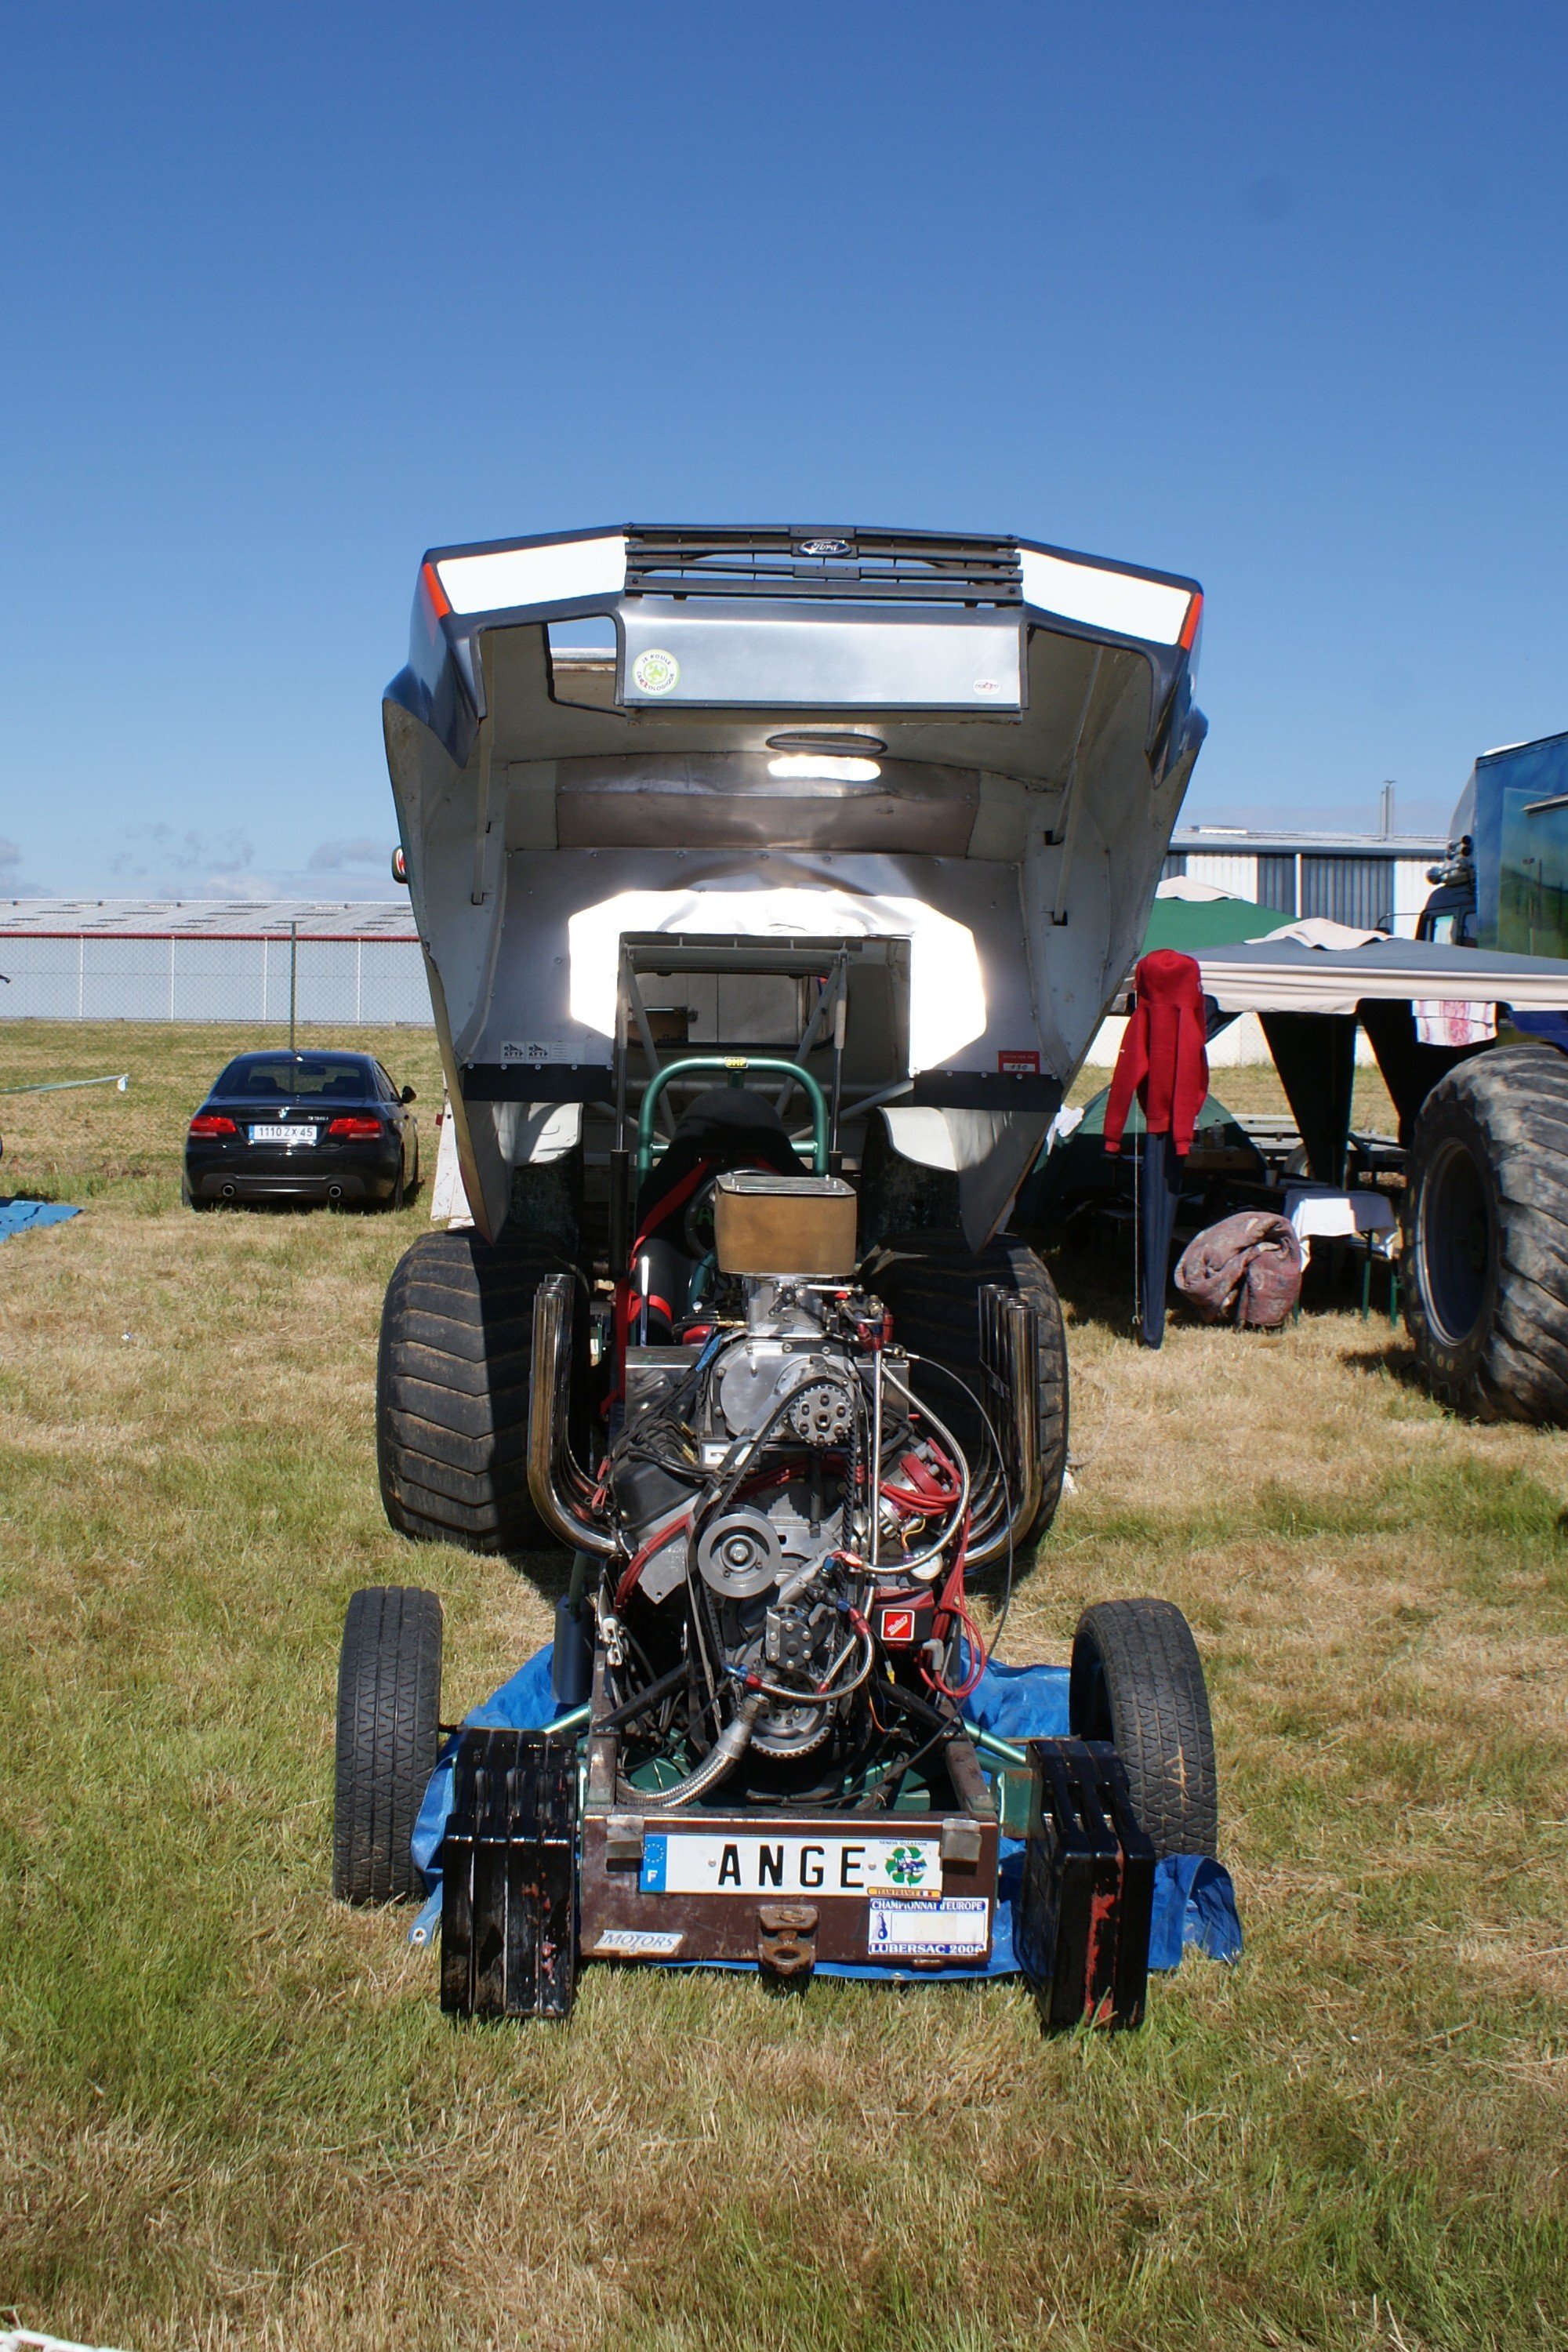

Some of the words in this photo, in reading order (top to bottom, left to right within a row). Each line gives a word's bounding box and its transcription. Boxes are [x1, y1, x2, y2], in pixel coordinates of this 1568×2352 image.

[260, 1127, 282, 1137] 1110
[285, 1127, 298, 1137] ZX
[299, 1127, 313, 1137] 45
[717, 1844, 866, 1888] ANGE
[647, 1870, 658, 1882] F
[603, 1933, 675, 1948] MOTORS
[870, 1944, 946, 1954] LUBERSAC
